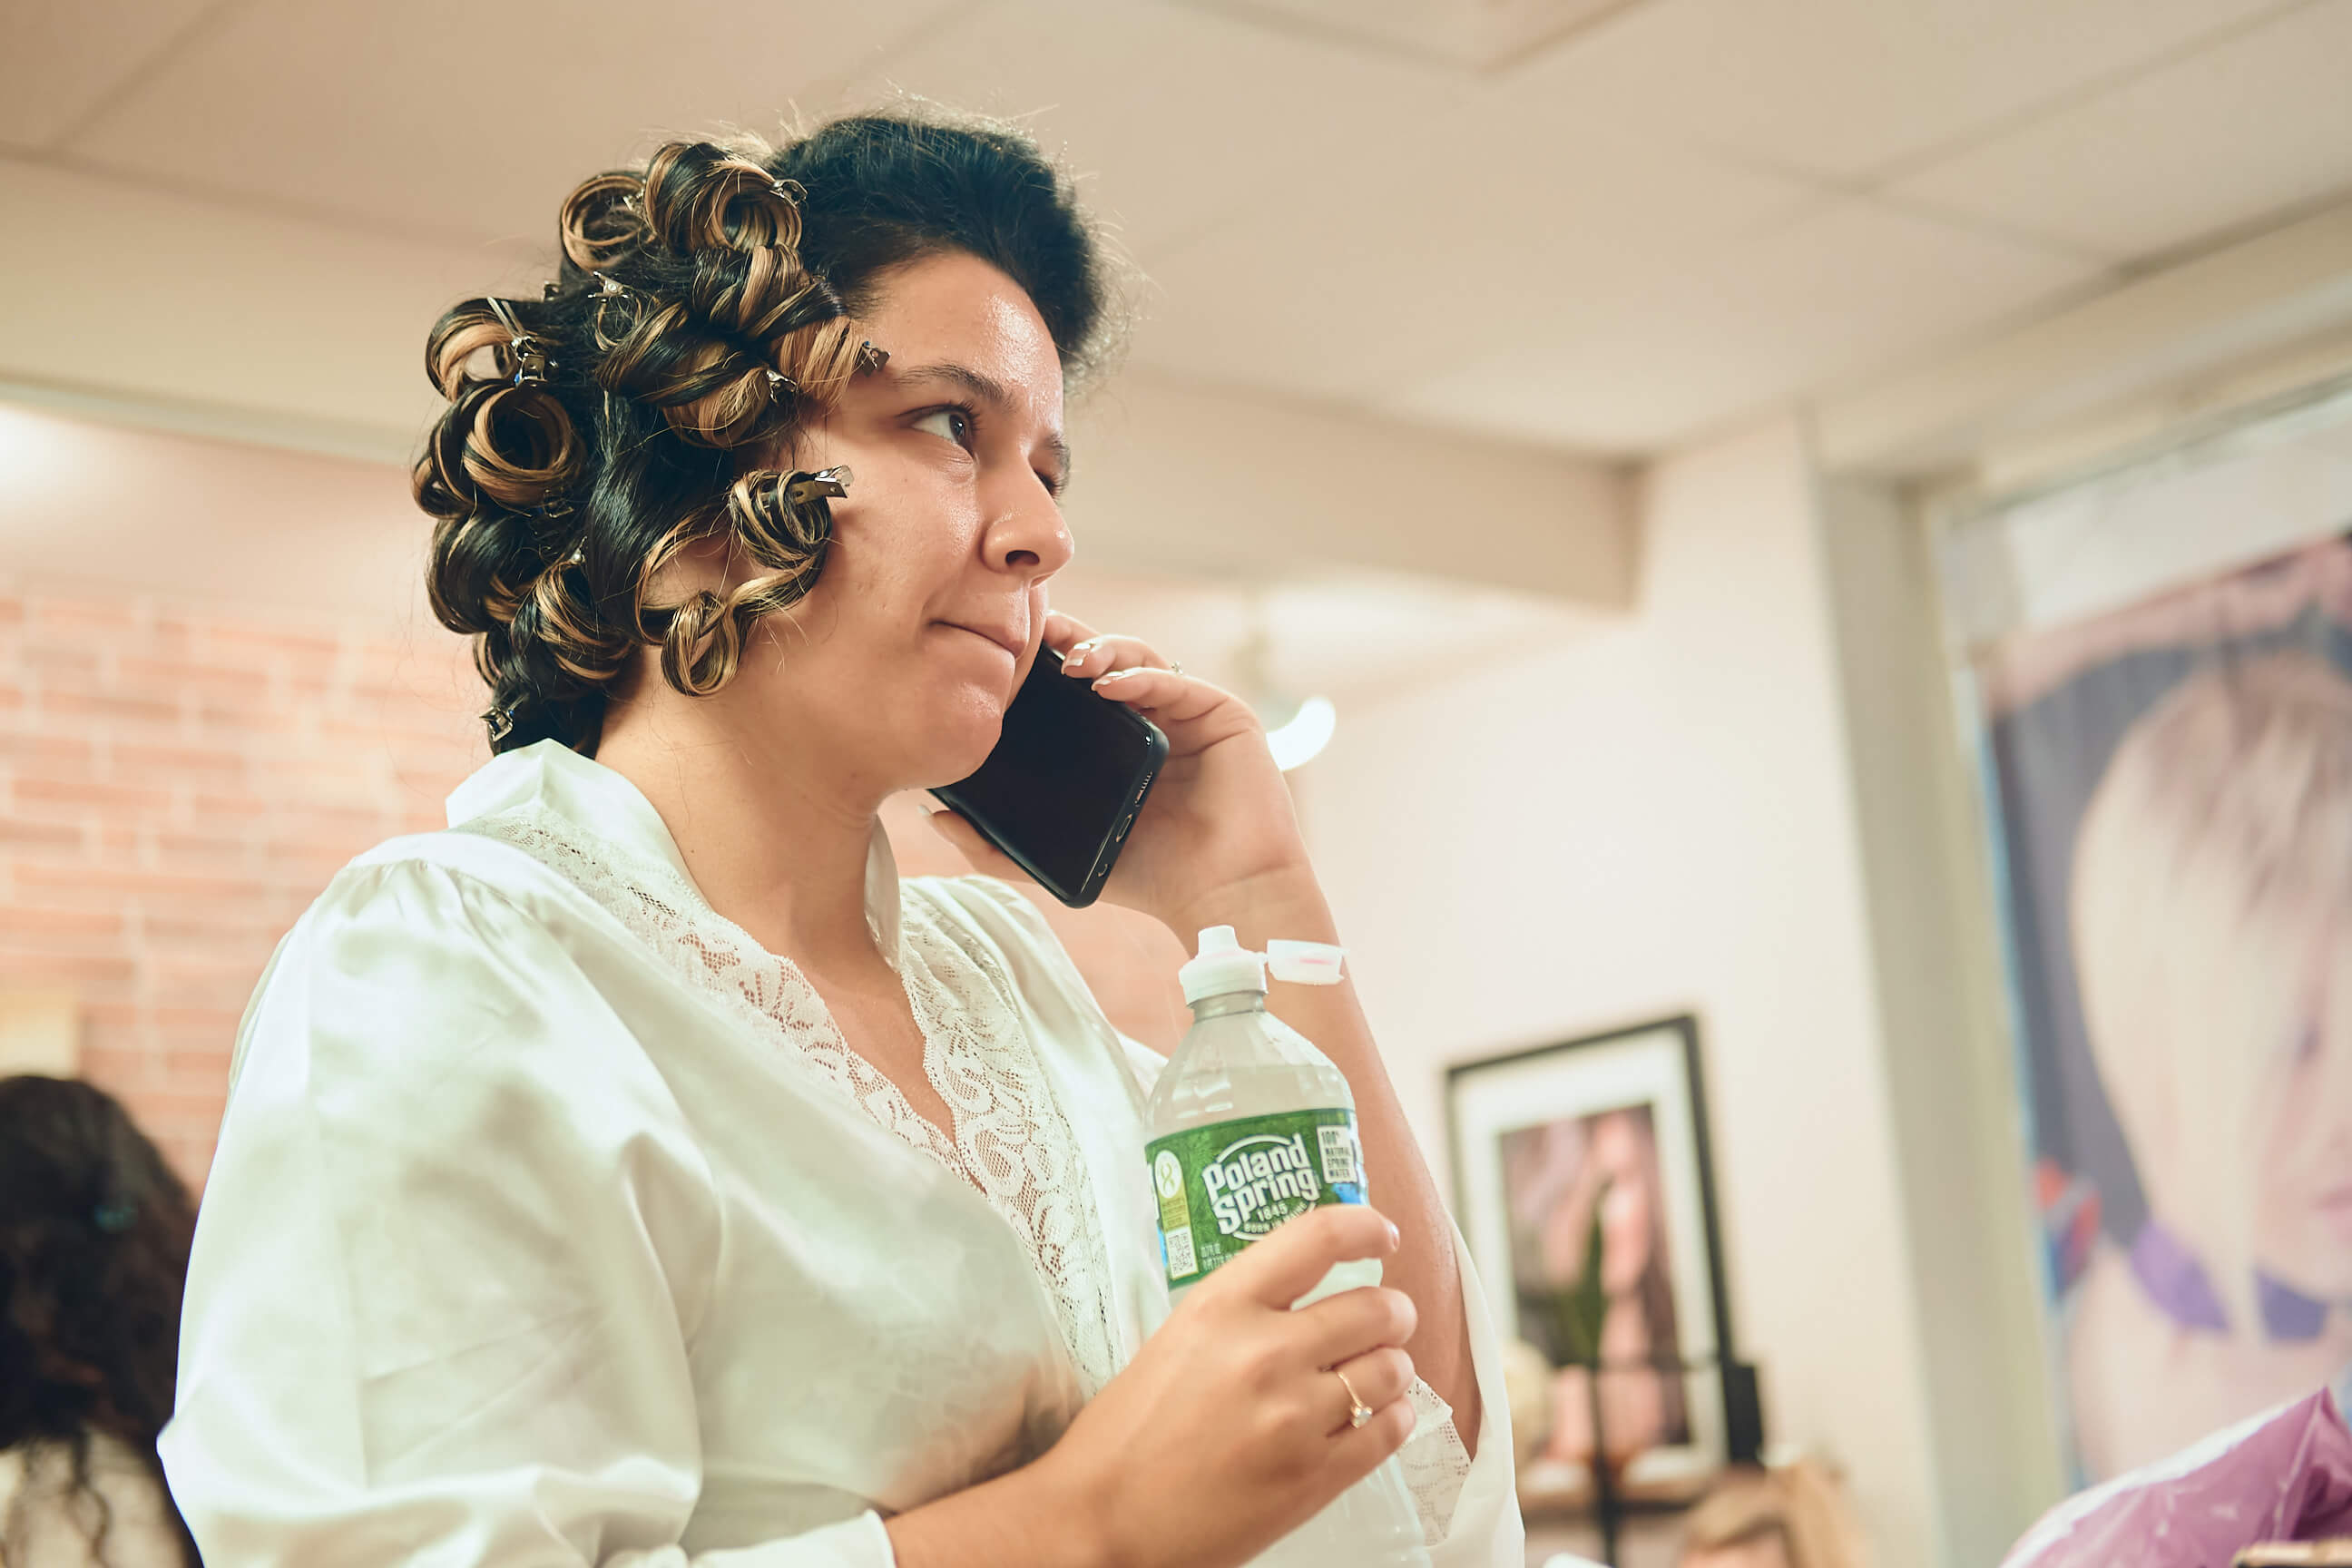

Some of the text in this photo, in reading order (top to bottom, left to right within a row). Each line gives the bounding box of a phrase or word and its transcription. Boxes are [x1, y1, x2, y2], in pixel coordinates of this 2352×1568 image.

[1202, 1132, 1312, 1205] Poland
[1328, 1157, 1351, 1168] SPRING
[1329, 1168, 1351, 1178] WATER
[1212, 1167, 1321, 1235] Spring
[1257, 1201, 1289, 1221] 1845
[1244, 1221, 1270, 1233] BORN
